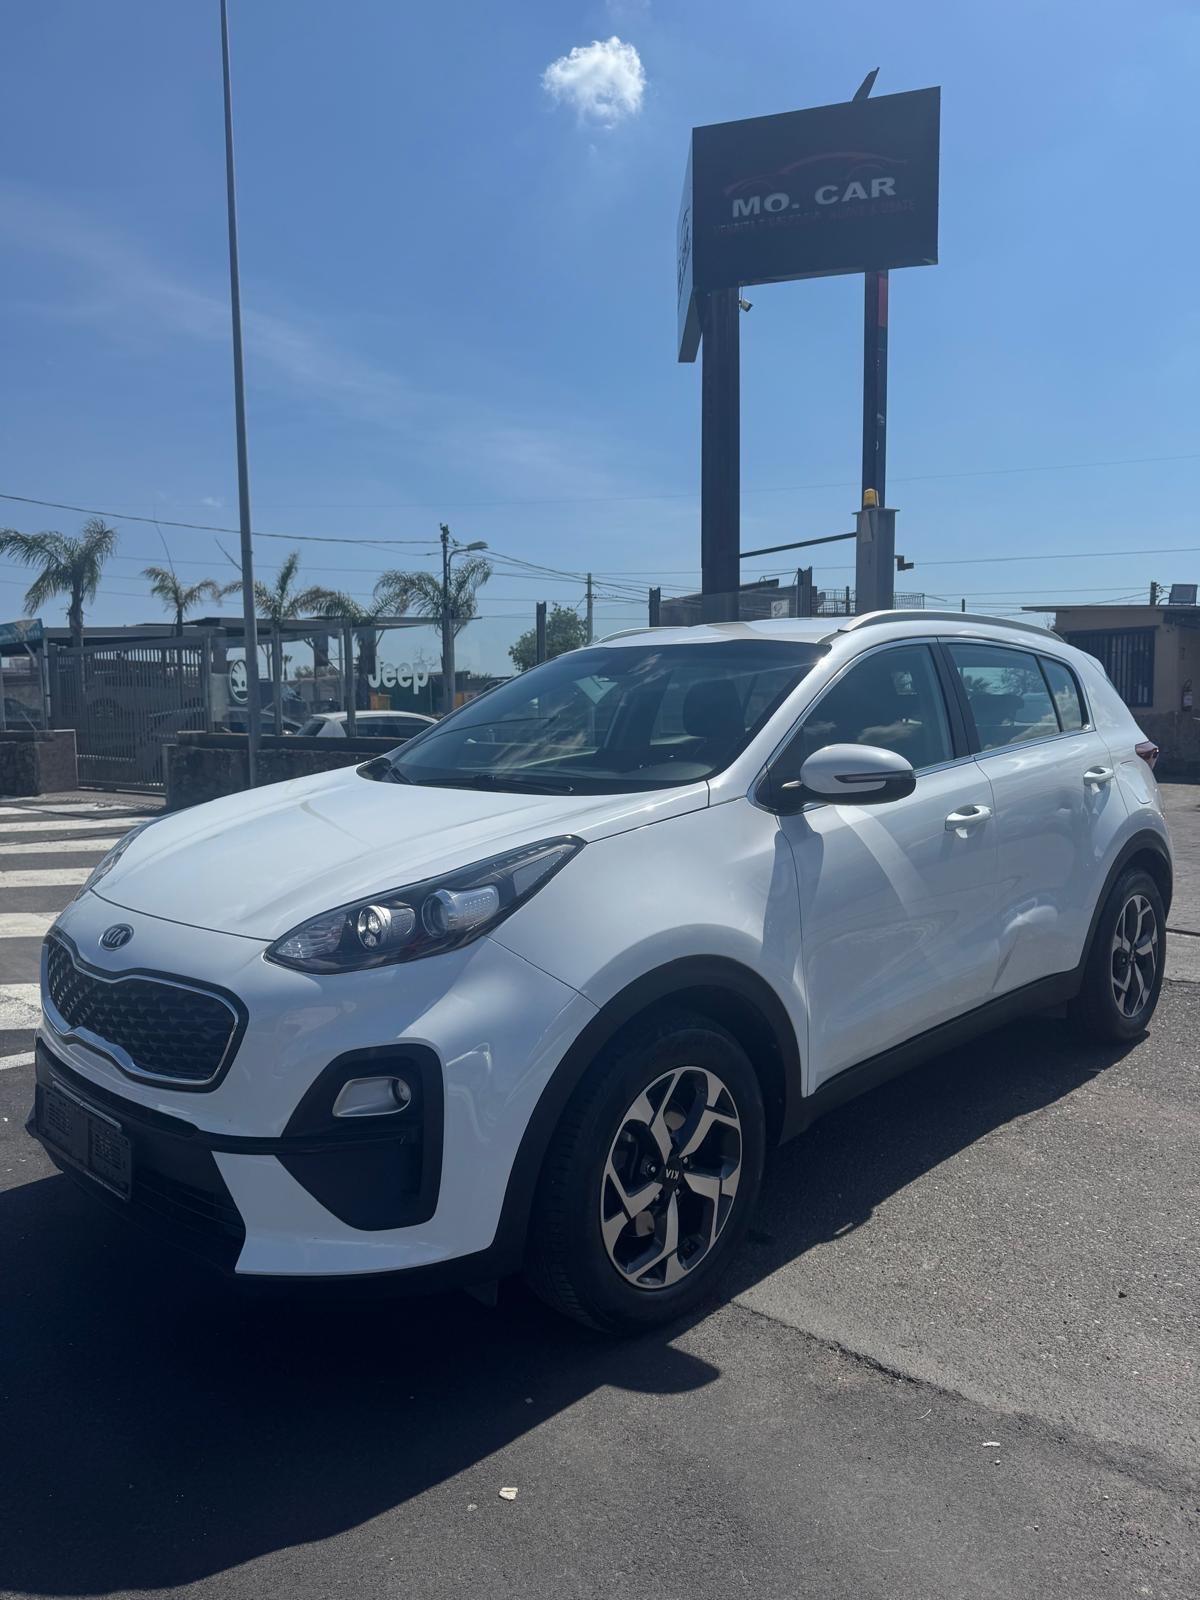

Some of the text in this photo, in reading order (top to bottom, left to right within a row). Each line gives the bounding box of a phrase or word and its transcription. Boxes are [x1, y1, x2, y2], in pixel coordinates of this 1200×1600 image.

[732, 192, 799, 218] MO.
[814, 176, 897, 206] CAR
[368, 656, 428, 695] Jeep
[103, 927, 127, 945] KIA
